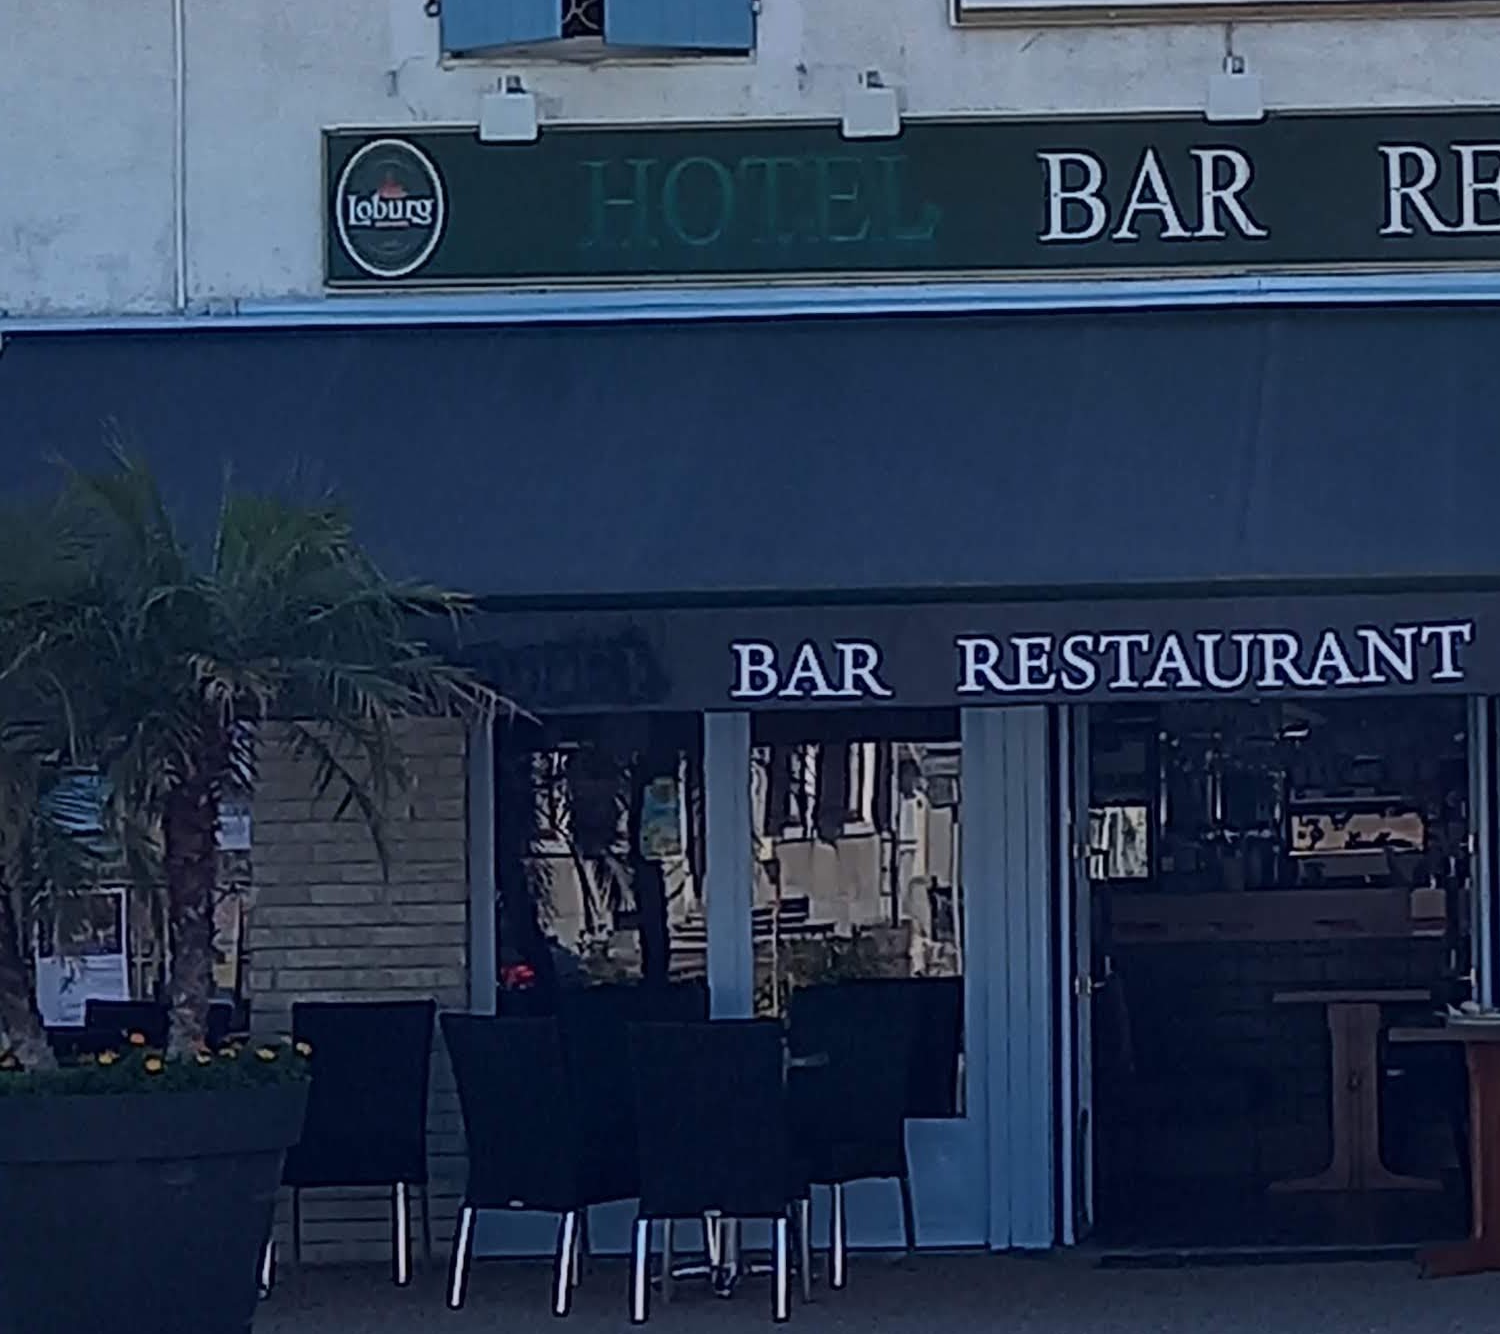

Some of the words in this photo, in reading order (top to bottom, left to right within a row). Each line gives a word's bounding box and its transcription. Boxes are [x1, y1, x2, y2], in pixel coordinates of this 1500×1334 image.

[347, 193, 434, 226] Loburg
[577, 149, 944, 249] HOTEL
[1038, 147, 1268, 242] BAR
[731, 641, 892, 697] BAR
[957, 623, 1474, 693] RESTAURANT
